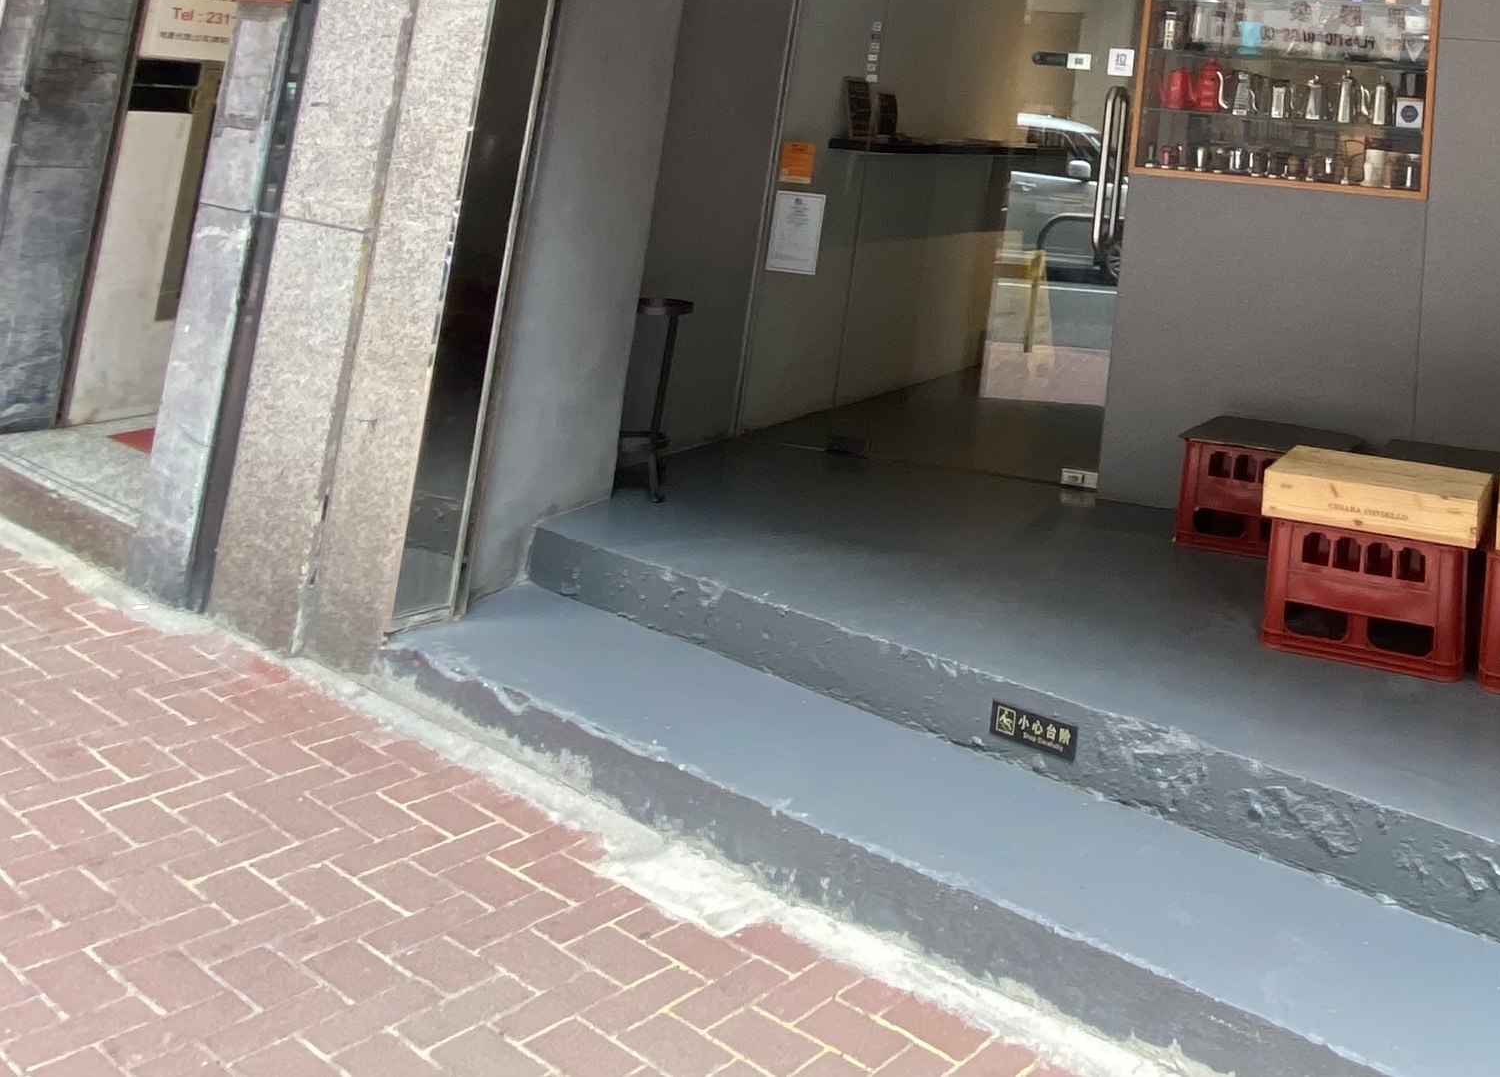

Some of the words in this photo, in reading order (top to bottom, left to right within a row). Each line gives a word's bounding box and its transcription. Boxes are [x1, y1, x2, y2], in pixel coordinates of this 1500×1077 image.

[172, 7, 194, 21] Tel
[206, 11, 237, 26] 231
[1017, 714, 1071, 746] 小心台阶
